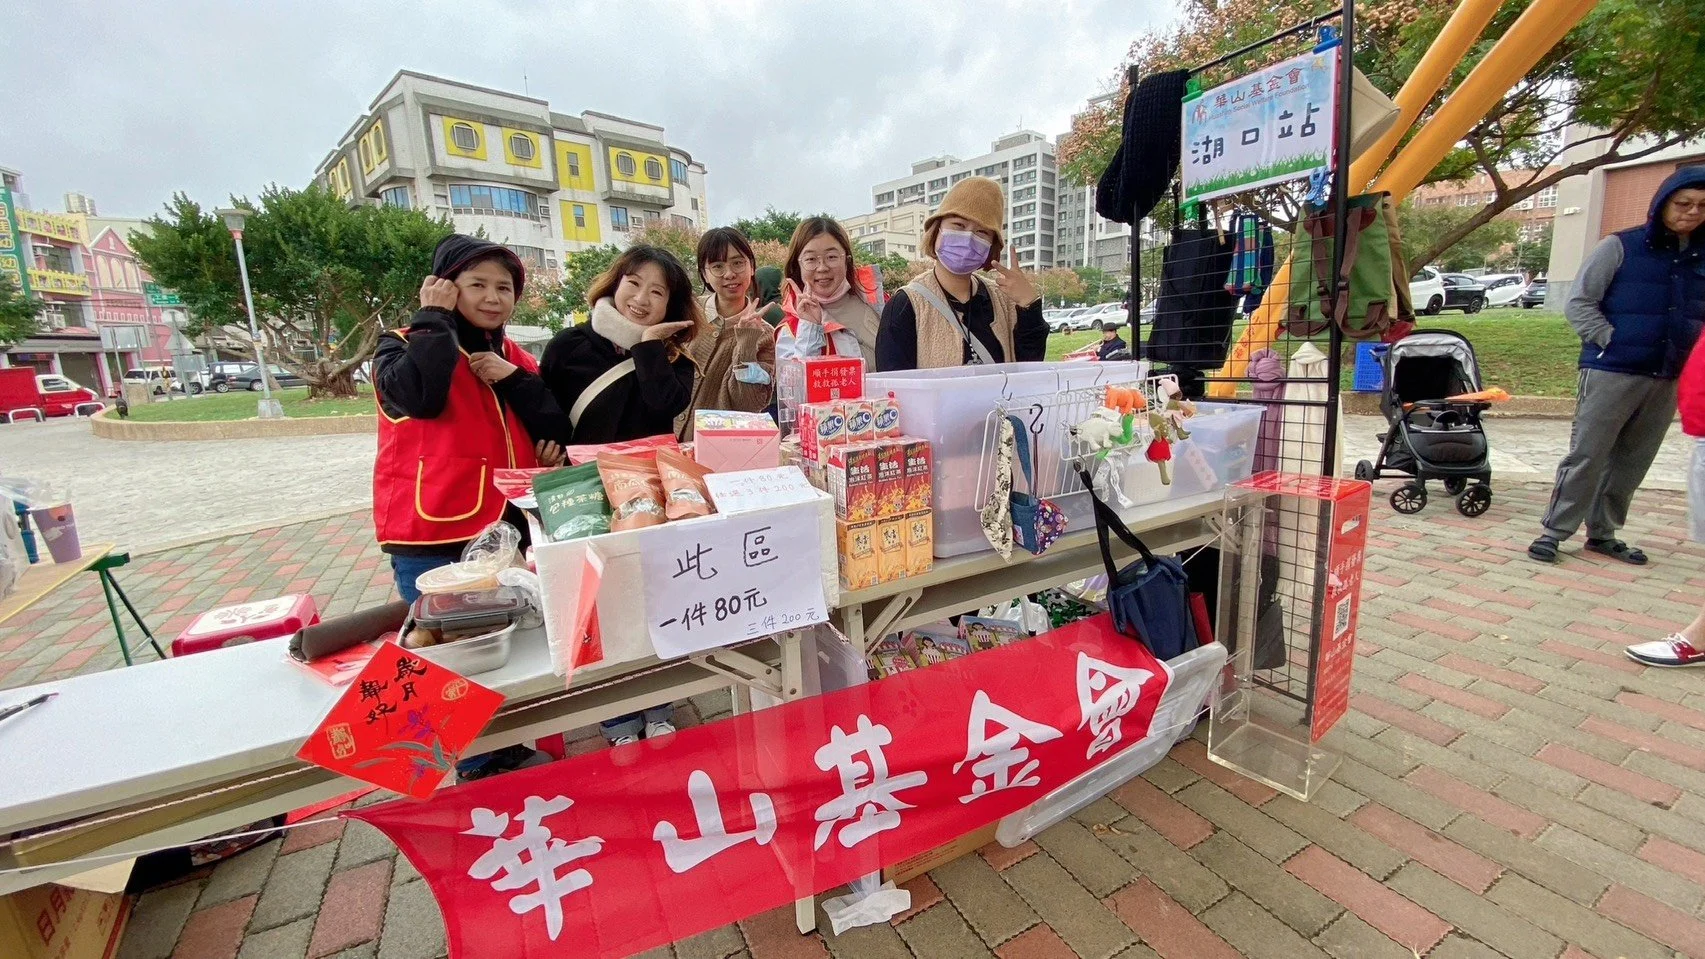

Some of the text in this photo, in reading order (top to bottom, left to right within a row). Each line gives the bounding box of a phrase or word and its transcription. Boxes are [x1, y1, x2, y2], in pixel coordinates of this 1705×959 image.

[1214, 67, 1302, 108] 華山基金會
[1192, 103, 1320, 164] 湖口站
[812, 366, 856, 378] 順手捐發票
[813, 377, 856, 388] 救救孤老人
[672, 526, 779, 580] 此區
[659, 588, 768, 631] 一件80元
[747, 608, 820, 635] 三件200元
[394, 656, 428, 701] 歲月
[459, 650, 1155, 941] 華山基金會
